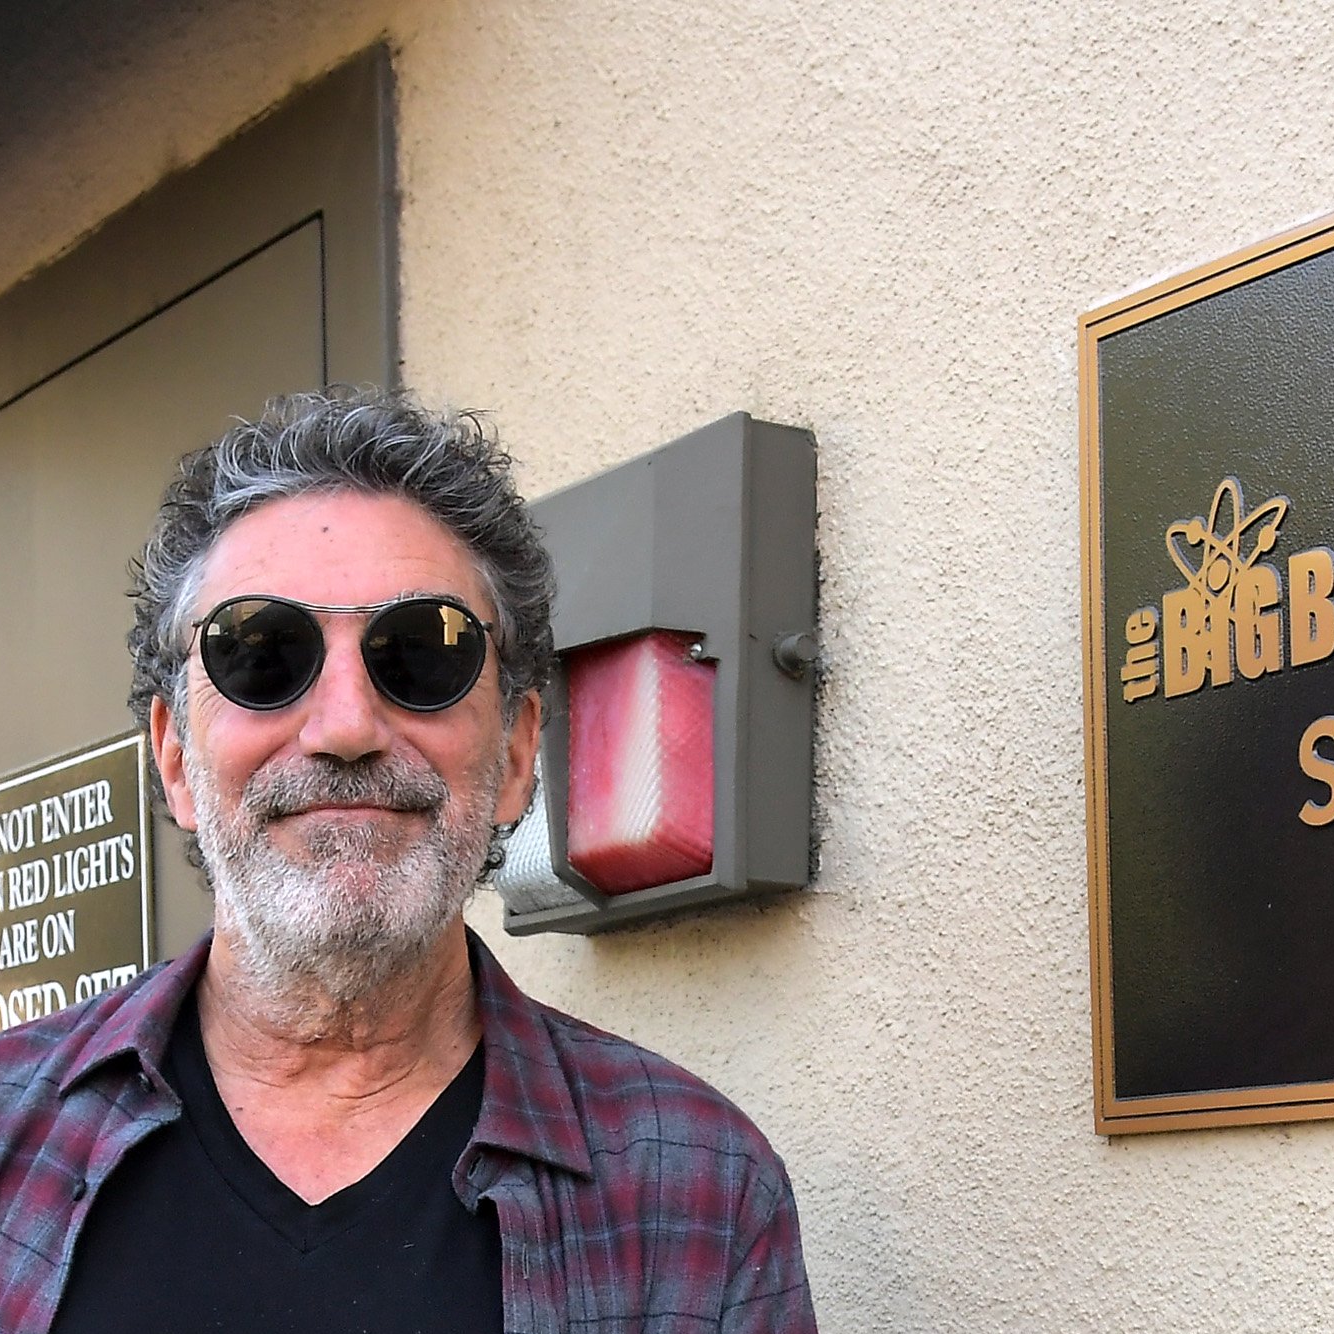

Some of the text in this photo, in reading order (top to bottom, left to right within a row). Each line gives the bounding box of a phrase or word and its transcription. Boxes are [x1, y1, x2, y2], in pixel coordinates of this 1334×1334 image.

[1121, 608, 1157, 702] the
[41, 780, 114, 843] ENTER
[8, 859, 50, 911] RED
[53, 833, 135, 898] LIGHTS
[42, 909, 75, 959] ON
